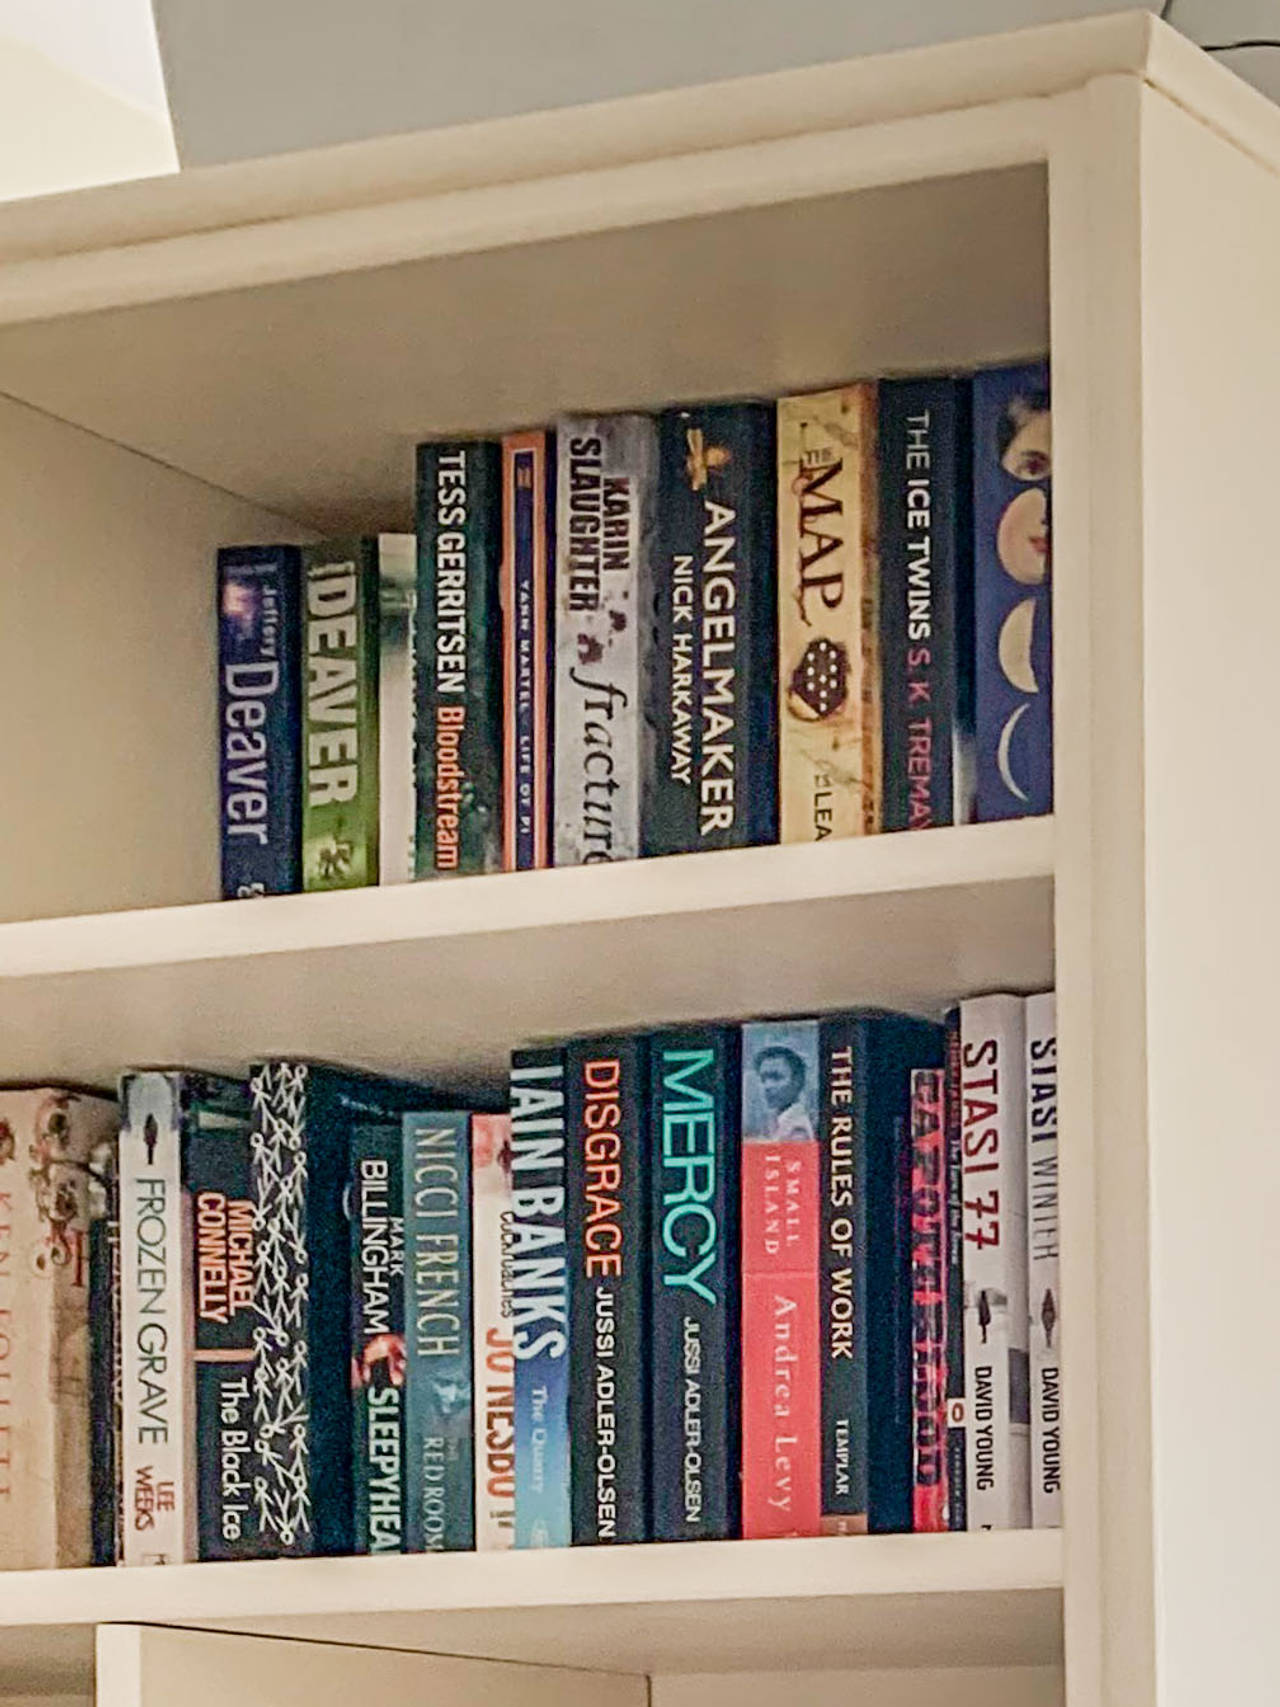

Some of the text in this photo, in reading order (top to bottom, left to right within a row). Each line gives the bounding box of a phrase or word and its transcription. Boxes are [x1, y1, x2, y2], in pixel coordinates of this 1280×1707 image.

[437, 450, 465, 694] TESS GERRITSEN
[569, 437, 600, 611] SLAUGHTER
[603, 477, 631, 571] KARIN
[906, 409, 931, 640] THE ICE TWINS
[225, 661, 279, 844] Deaver
[671, 556, 693, 784] NICK HARKAWAY
[702, 502, 736, 835] ANGELMAKER
[435, 706, 465, 870] Bloodstream
[361, 1160, 389, 1334] BILLINGHAM
[415, 1129, 461, 1358] NICCI FRENCH
[510, 1066, 567, 1362] IAIN BANKS
[583, 1058, 621, 1279] DISGRACE
[662, 1049, 716, 1304] MERCY
[764, 1155, 781, 1255] ISLAND
[785, 1161, 802, 1247] SMALL
[831, 1046, 855, 1359] THE RULES OF WORK
[963, 1040, 1001, 1250] STASI 77
[136, 1178, 168, 1444] FROZEN GRAVE
[198, 1193, 227, 1323] CONNELLY
[220, 1377, 250, 1541] The Black Ice
[596, 1287, 618, 1538] JUSSI ADLER-OLSEN
[684, 1317, 701, 1522] JUSSI ADLER-OLSEN
[768, 1296, 799, 1512] Andrea Levy
[978, 1365, 994, 1491] DAVID YOUNG
